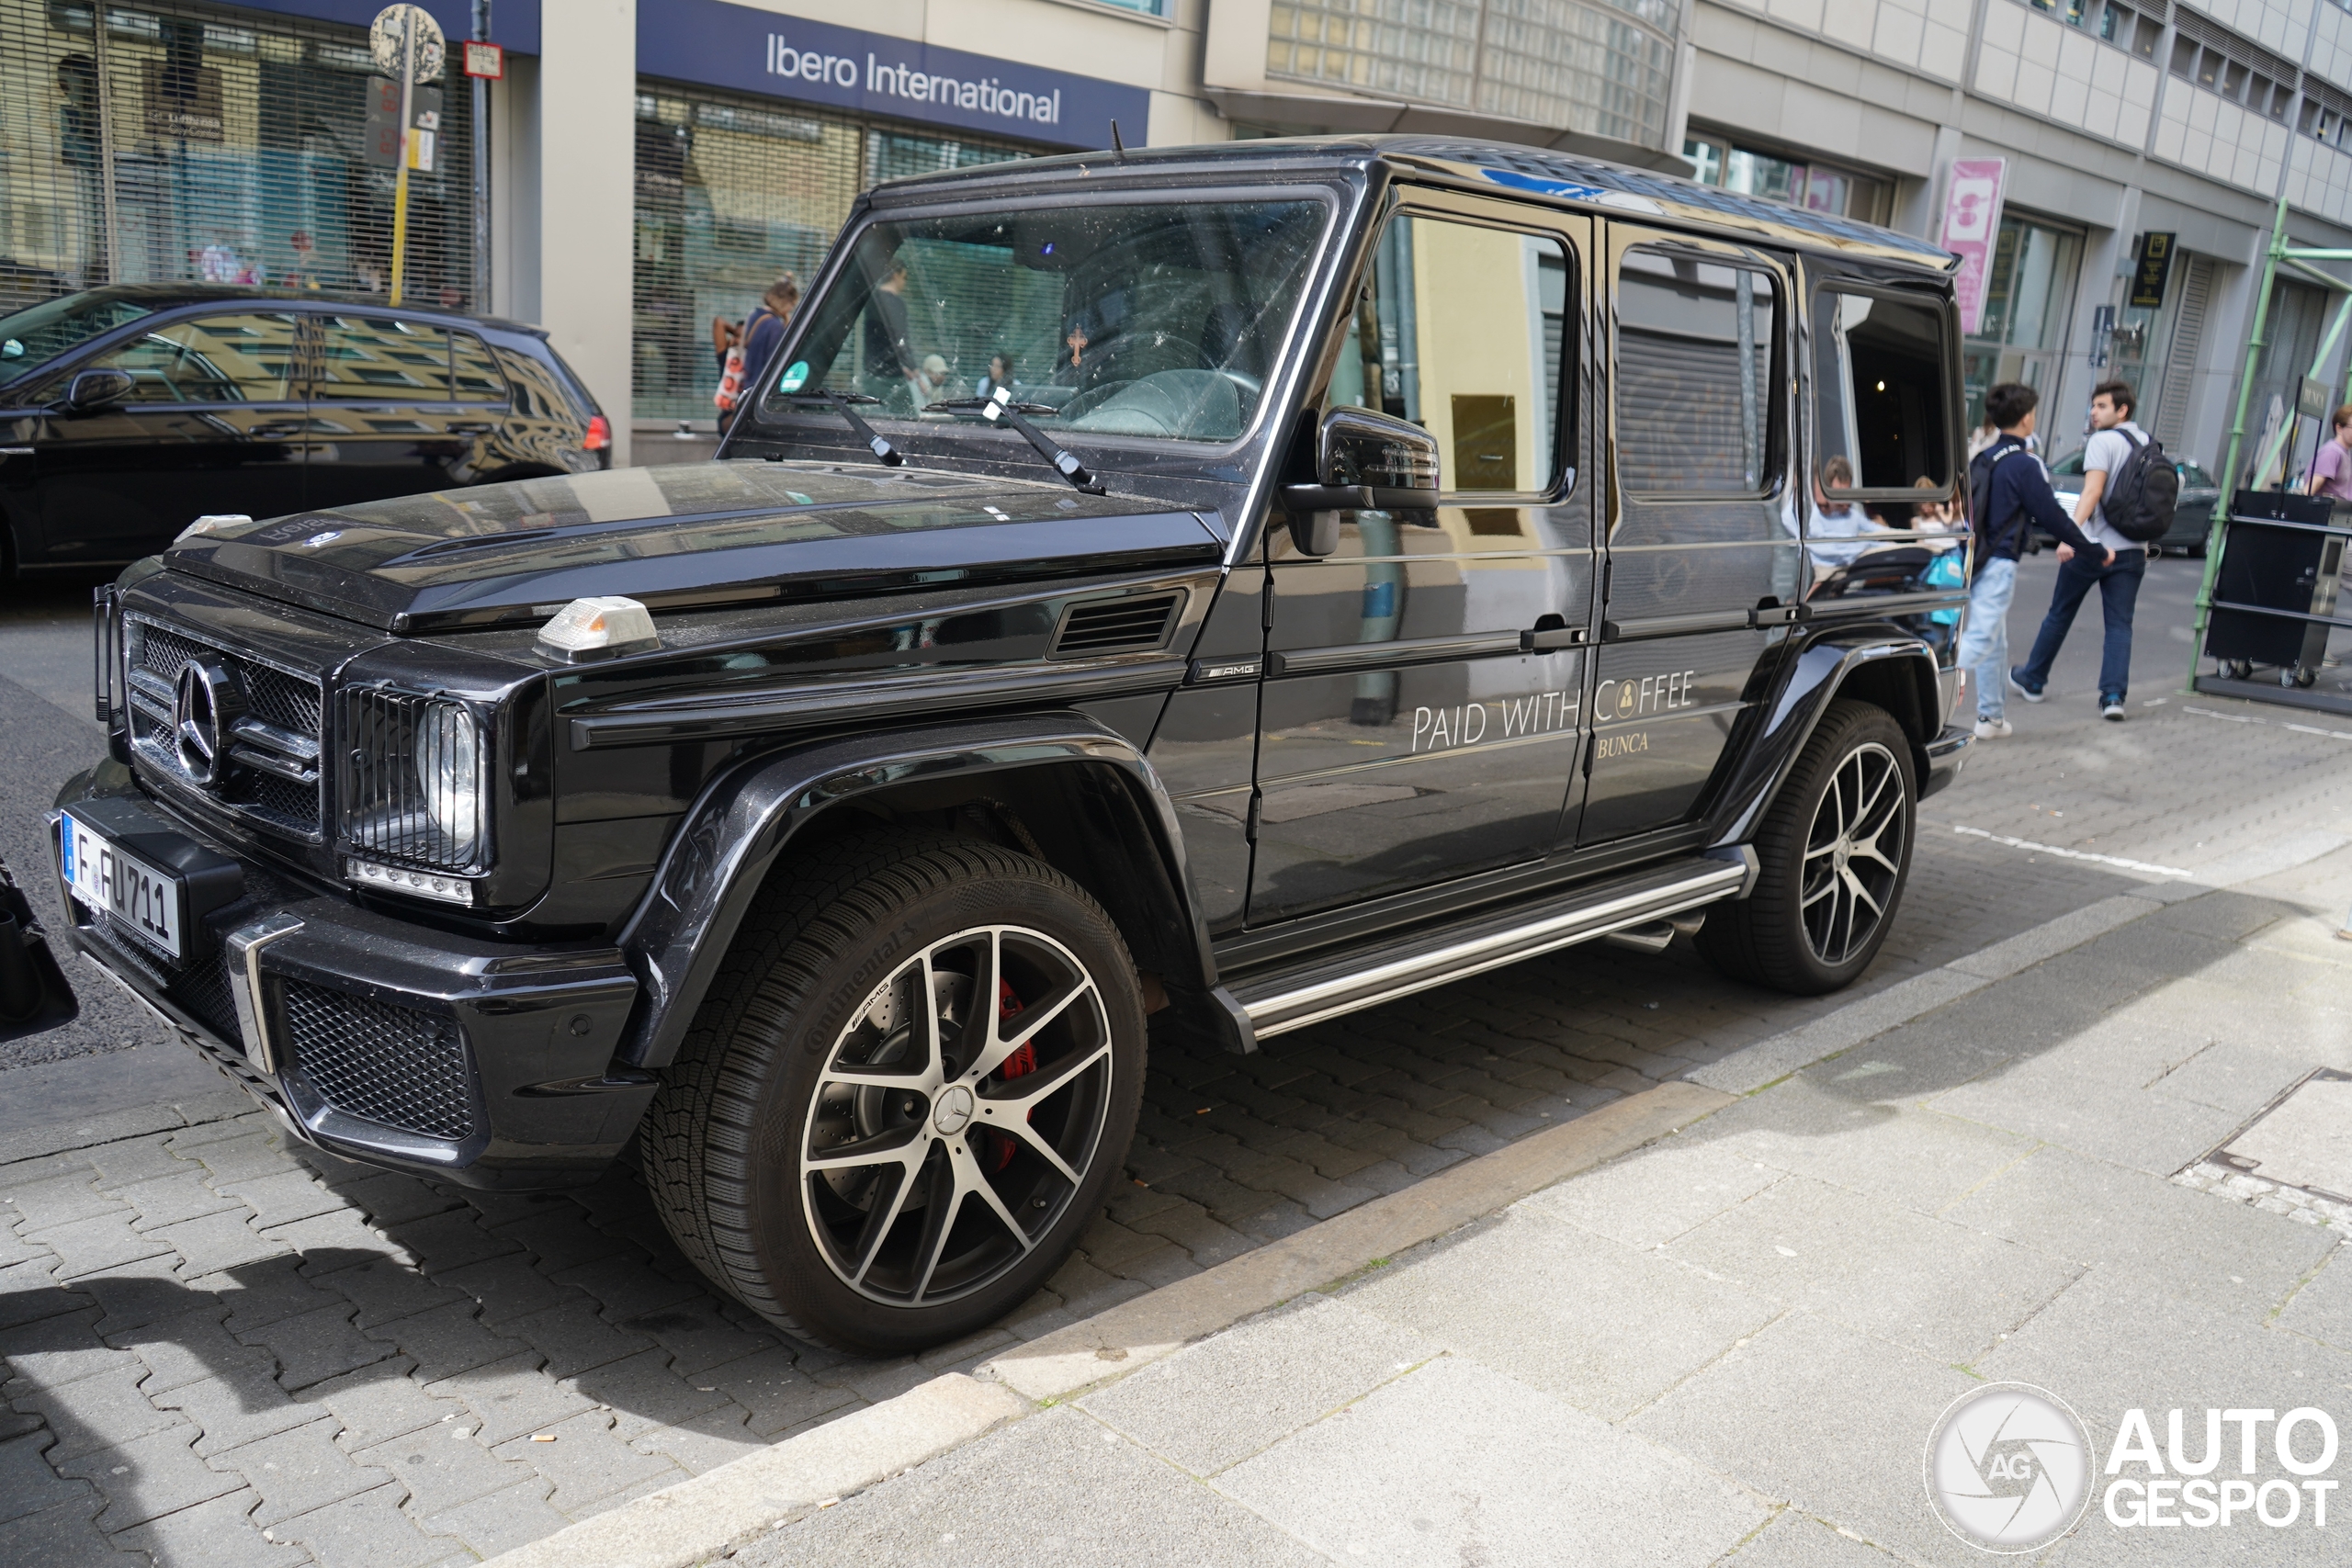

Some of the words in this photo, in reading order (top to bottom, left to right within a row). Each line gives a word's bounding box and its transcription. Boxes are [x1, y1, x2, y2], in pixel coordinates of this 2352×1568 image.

[766, 33, 858, 87] Ibero
[866, 51, 1060, 124] International
[1223, 665, 1254, 676] AMG
[1412, 705, 1487, 752] PAID
[1501, 689, 1582, 738] WITH
[1597, 731, 1649, 769] BUNCA
[803, 930, 902, 1056] Continental
[863, 982, 889, 1015] AMG
